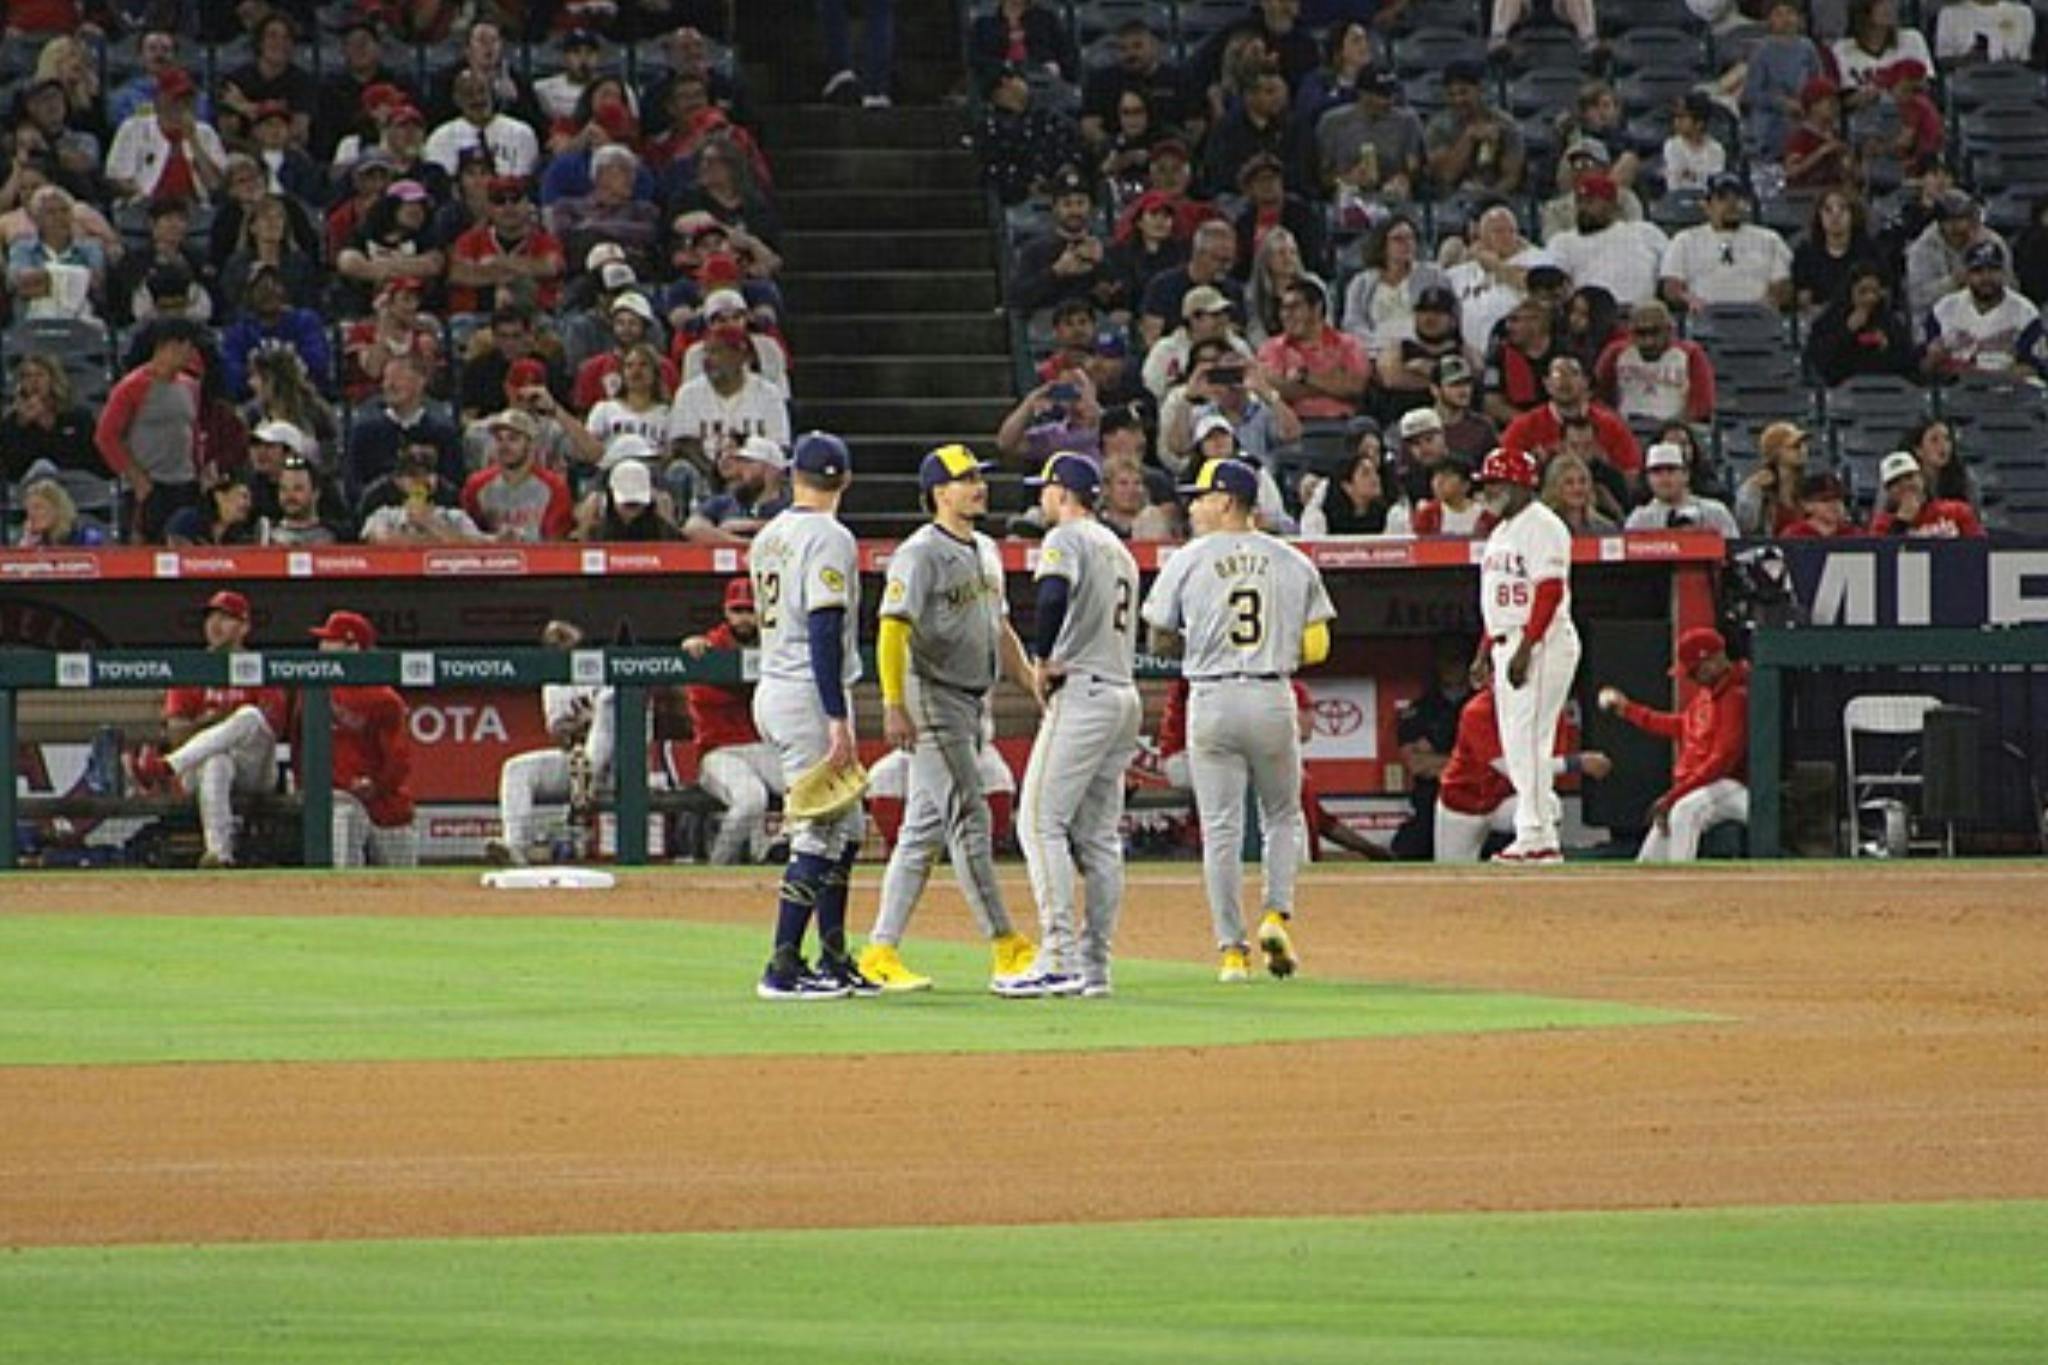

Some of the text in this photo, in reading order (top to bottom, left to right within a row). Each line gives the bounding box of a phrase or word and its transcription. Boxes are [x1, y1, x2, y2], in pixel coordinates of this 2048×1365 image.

[1625, 541, 1681, 552] TOYOTA
[181, 557, 236, 570] TOYOTA
[315, 557, 368, 570] TOYOTA
[608, 555, 662, 567] TOYOTA
[1214, 555, 1270, 578] ORTIZ
[1496, 581, 1529, 608] 85
[1113, 576, 1133, 634] 2
[1228, 588, 1262, 646] 3
[97, 660, 172, 678] TOYOTA
[269, 660, 345, 678] TOYOTA
[440, 660, 516, 677] TOYOTA
[610, 657, 686, 675] TOYOTA
[404, 705, 509, 744] OTA
